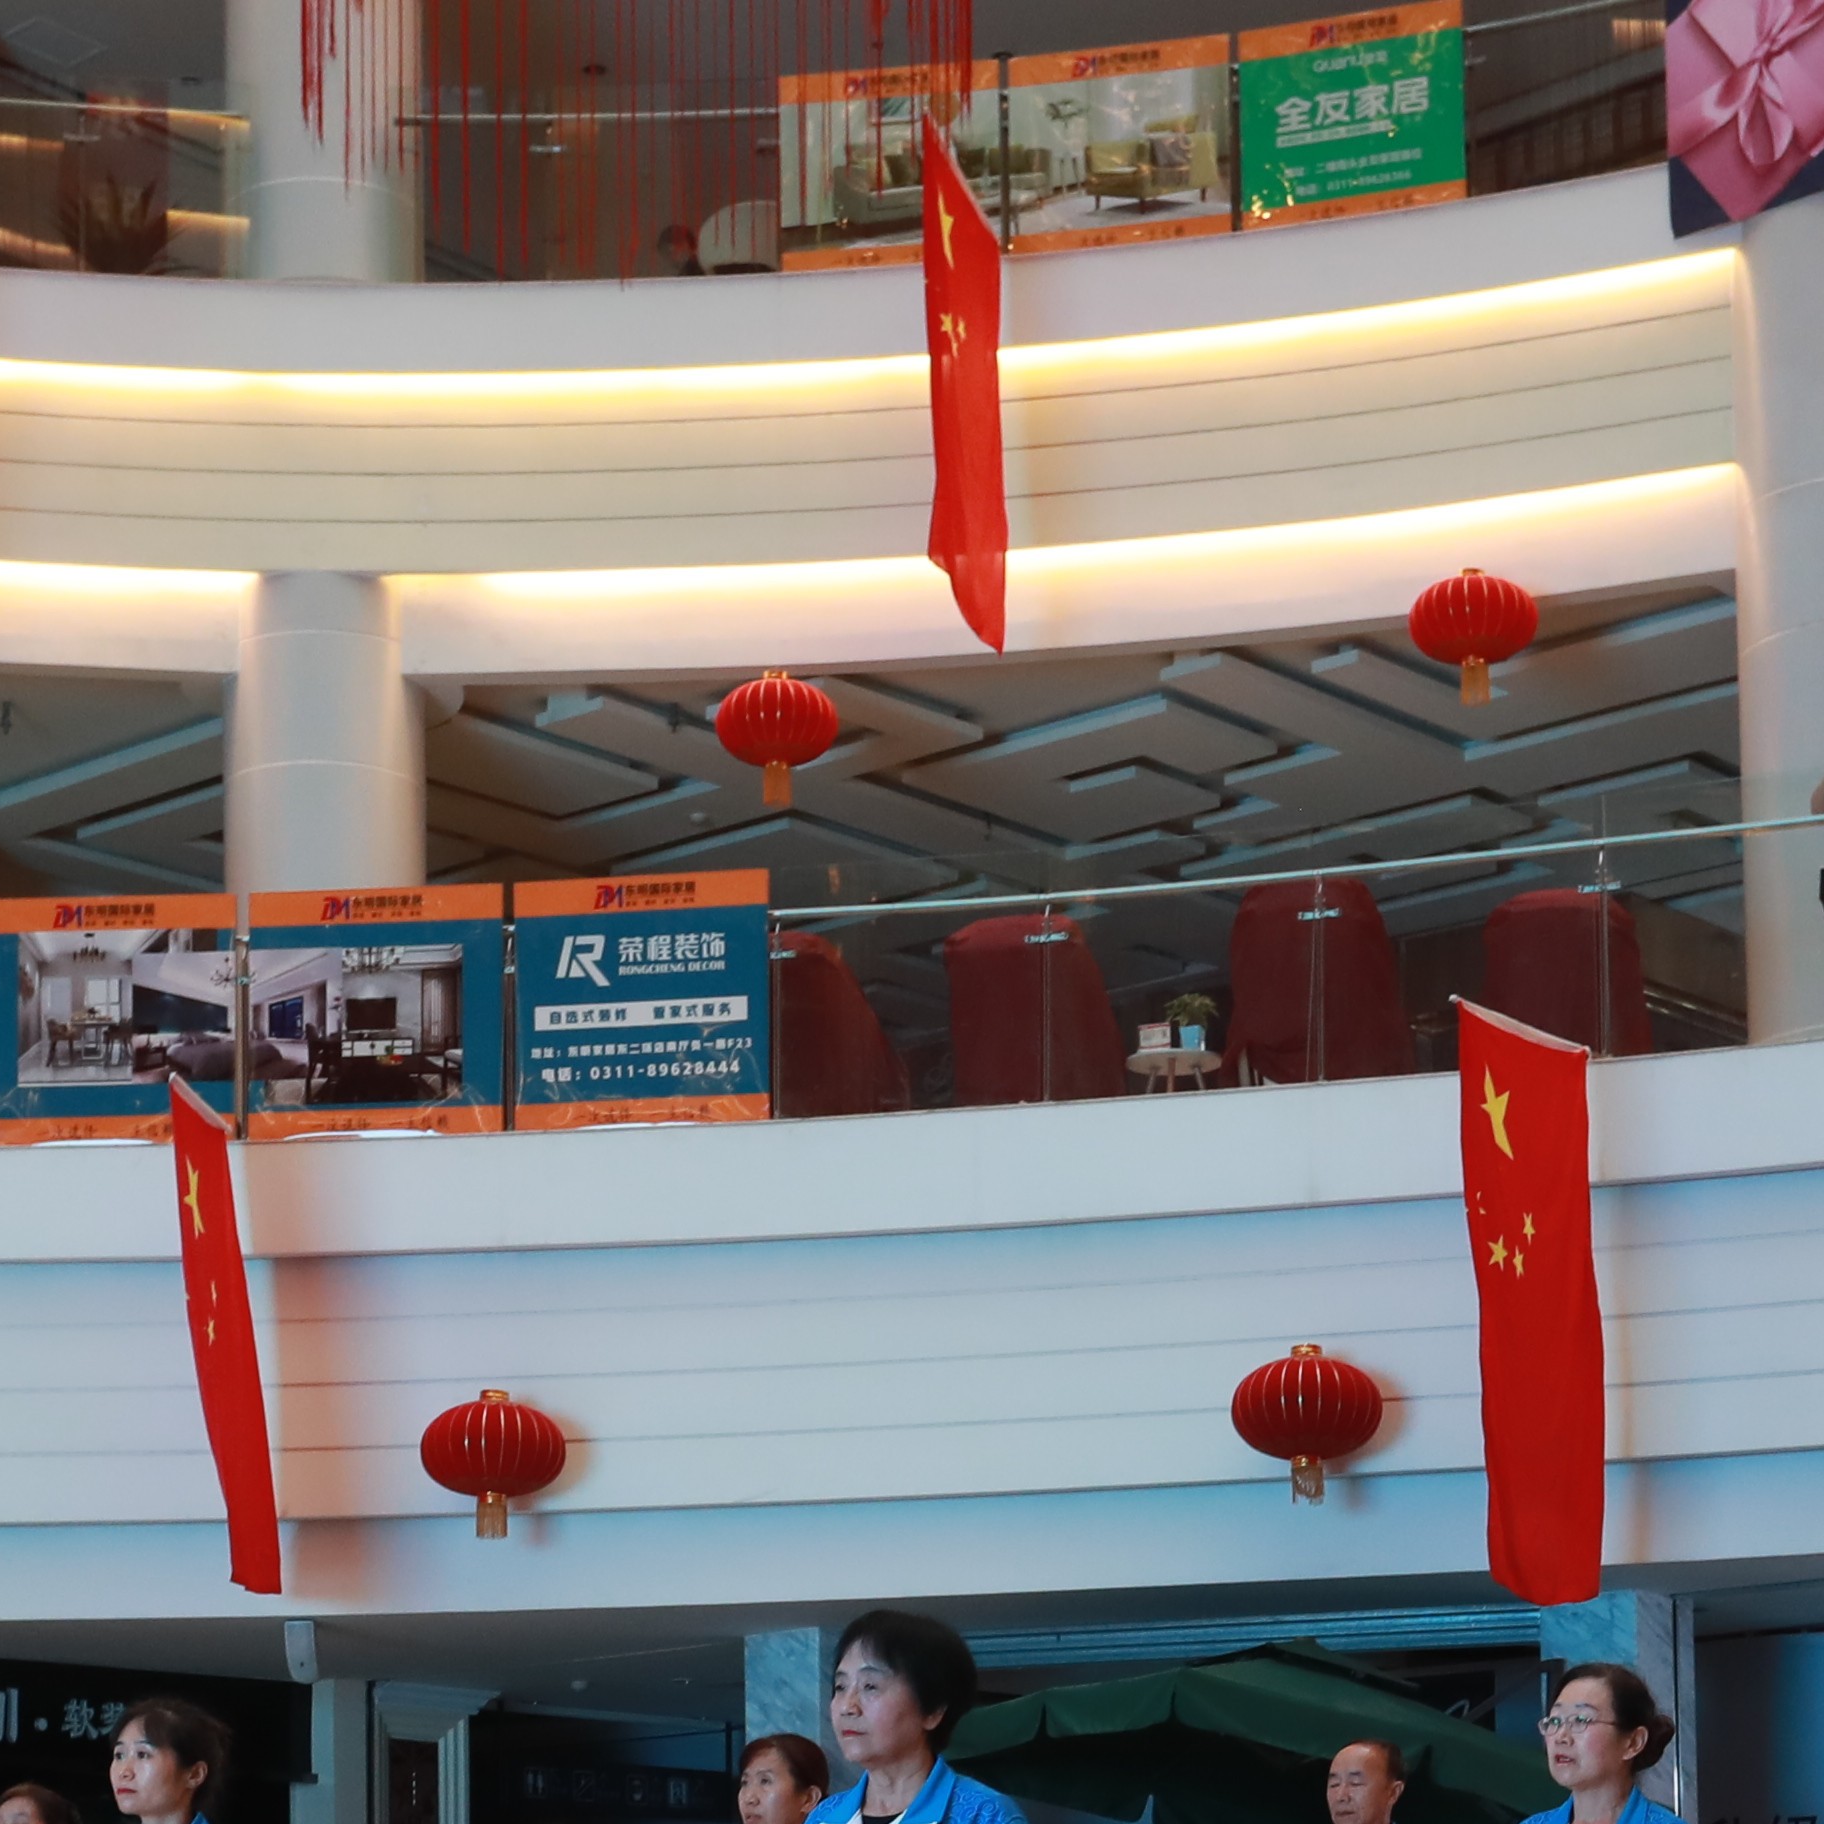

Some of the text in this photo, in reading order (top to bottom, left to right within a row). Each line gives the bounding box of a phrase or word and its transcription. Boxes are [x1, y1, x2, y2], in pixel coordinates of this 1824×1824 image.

[1276, 77, 1429, 133] 全友家居
[618, 932, 725, 963] 荣程装饰
[688, 960, 725, 972] DECOR
[549, 1003, 732, 1025] 自选式装修 管家式服务
[590, 1059, 741, 1080] 0311-89628444
